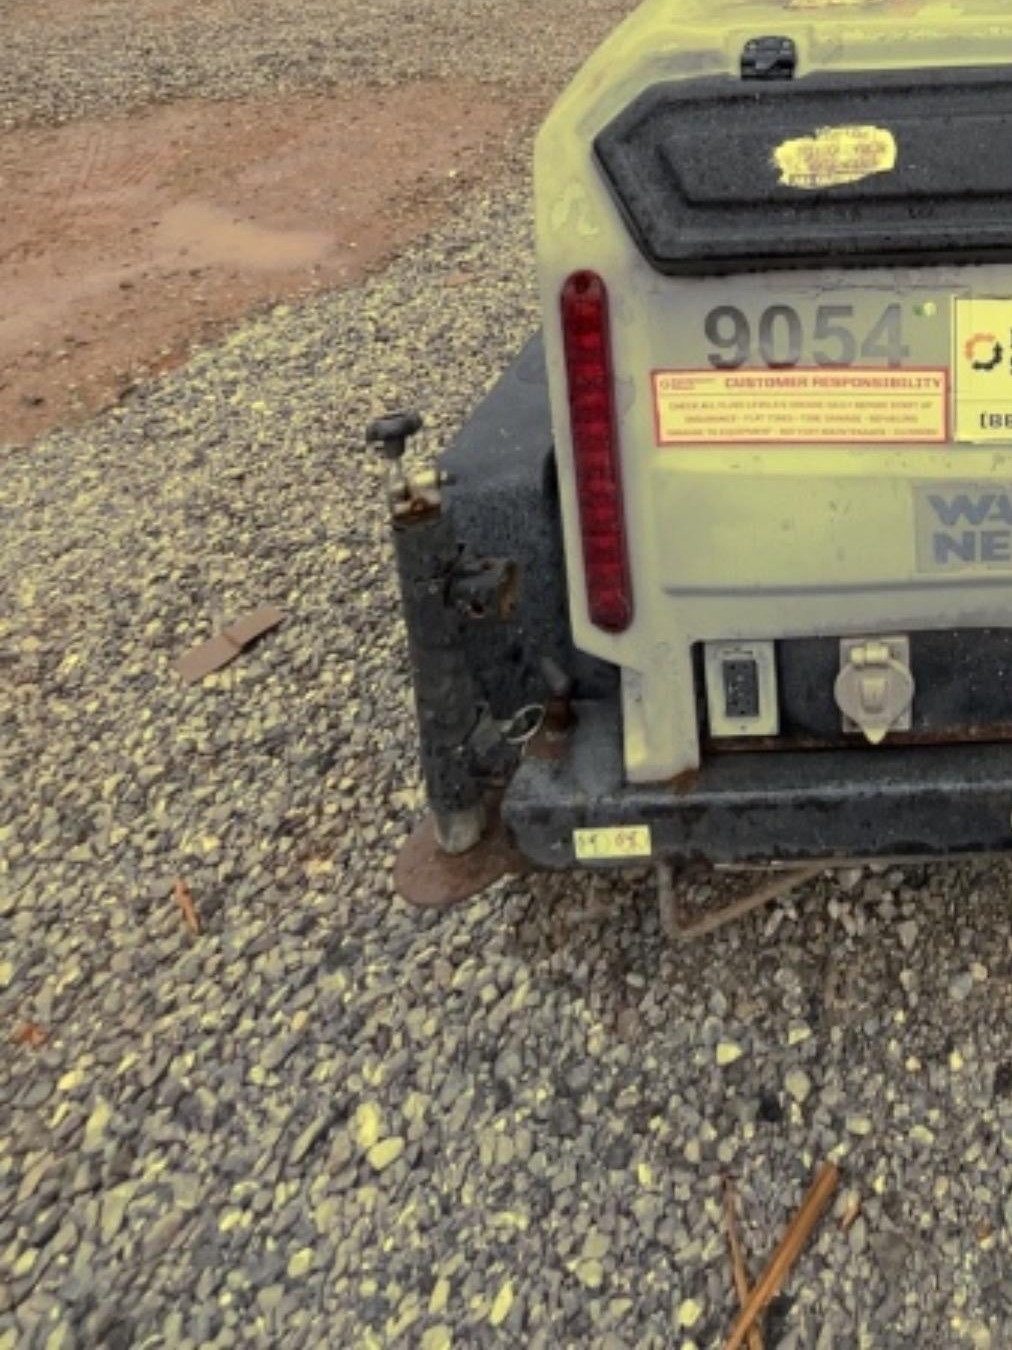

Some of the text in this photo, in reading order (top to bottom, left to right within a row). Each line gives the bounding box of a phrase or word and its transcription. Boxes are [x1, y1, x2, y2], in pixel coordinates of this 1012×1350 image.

[704, 303, 911, 369] 9054
[725, 376, 808, 388] CUSTOMER
[812, 376, 941, 388] RESPONSIBILITY
